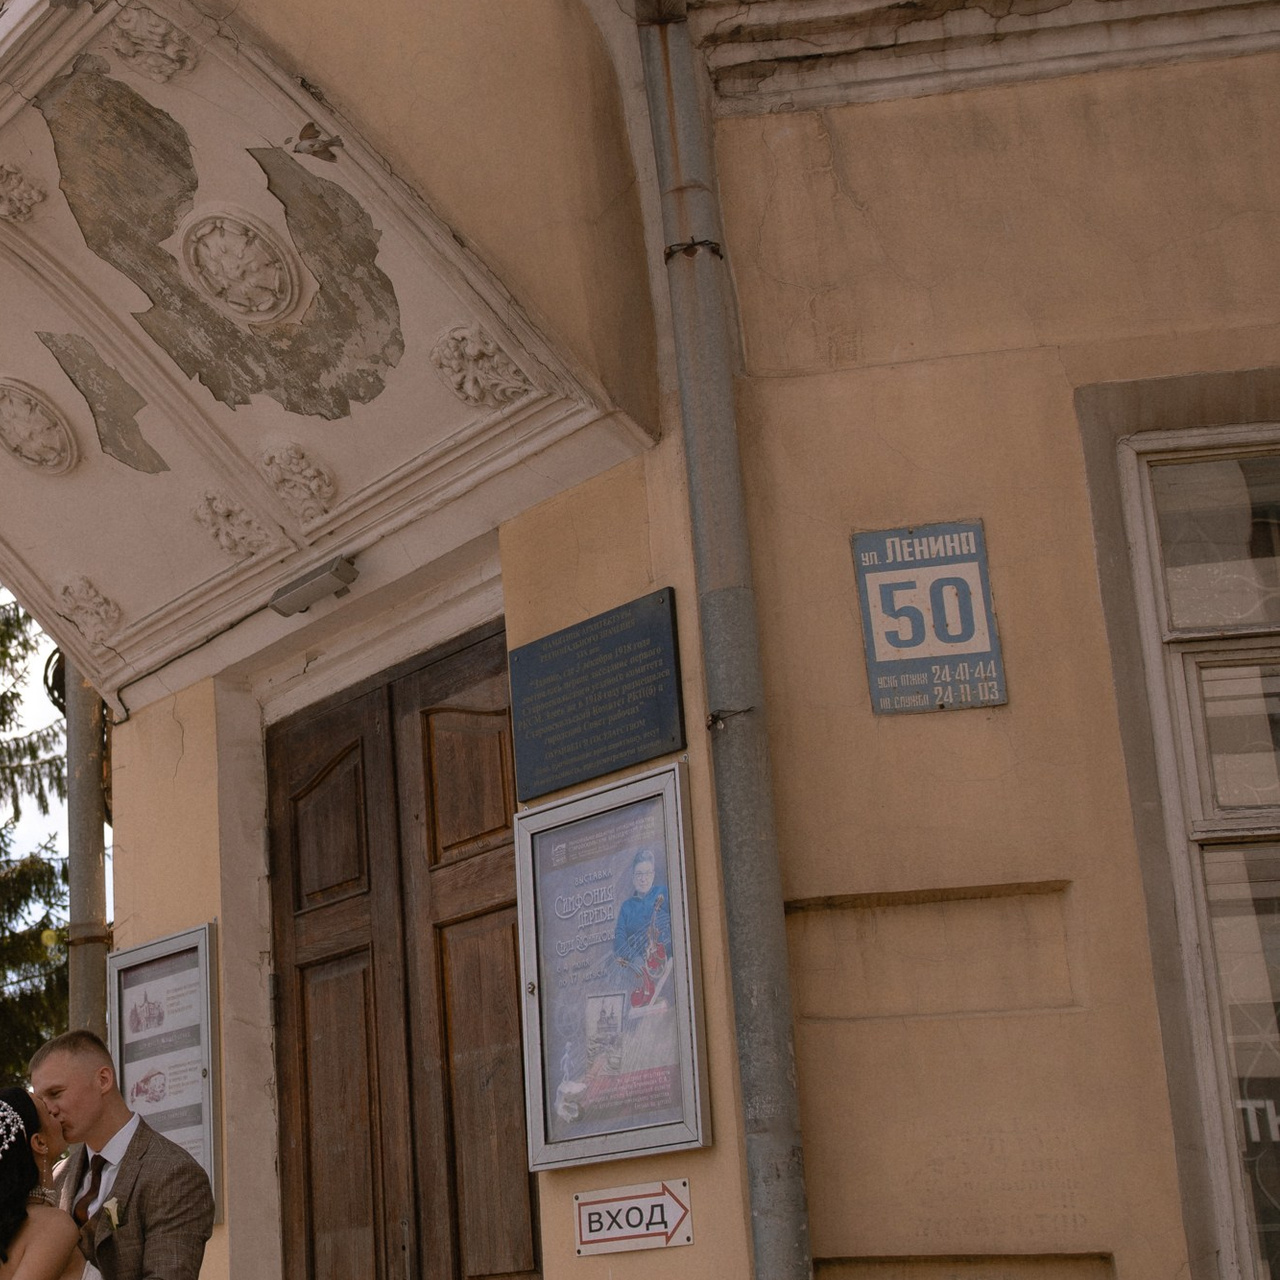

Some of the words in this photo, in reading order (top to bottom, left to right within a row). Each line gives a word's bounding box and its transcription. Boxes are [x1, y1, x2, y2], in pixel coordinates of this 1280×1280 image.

[878, 576, 976, 649] 50
[614, 642, 631, 657] 1918
[931, 659, 998, 684] 24-41-44
[933, 681, 999, 705] 24-11-03
[575, 870, 613, 886] ВЫСТАВКА
[588, 1204, 668, 1233] ВХОД
